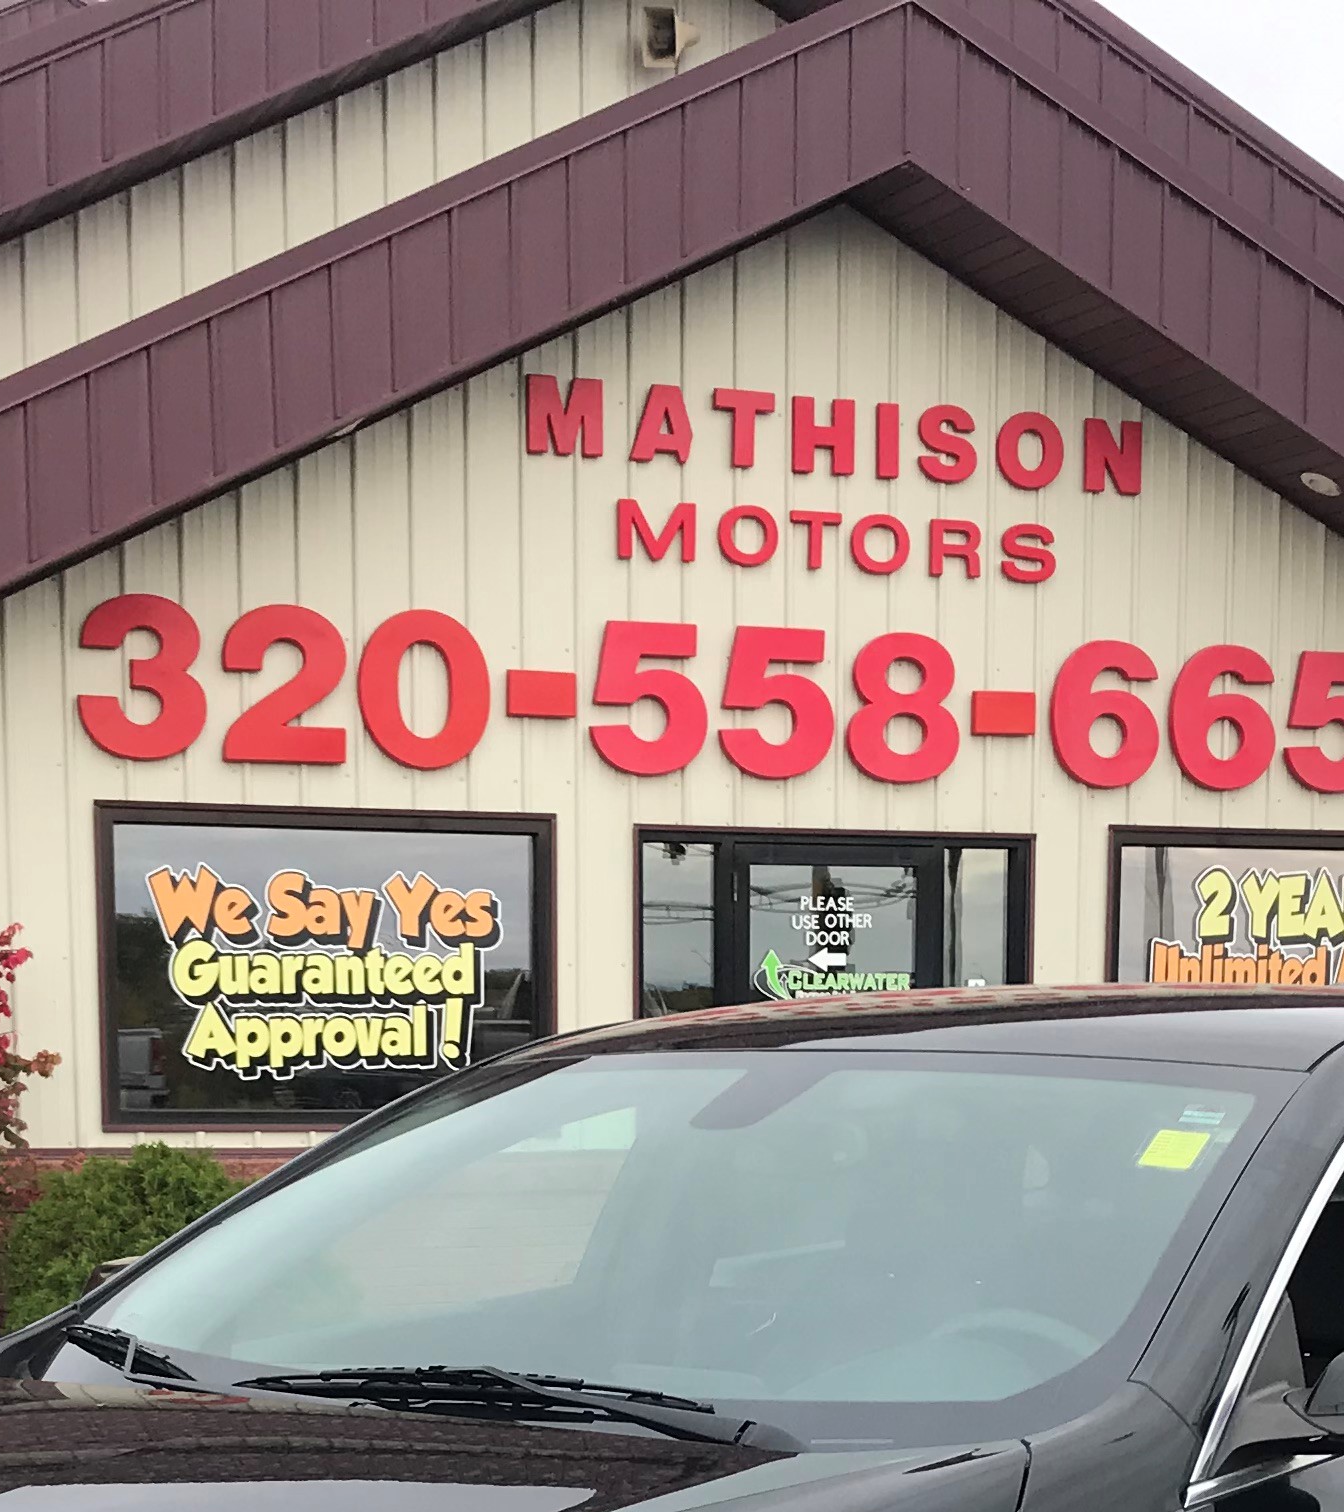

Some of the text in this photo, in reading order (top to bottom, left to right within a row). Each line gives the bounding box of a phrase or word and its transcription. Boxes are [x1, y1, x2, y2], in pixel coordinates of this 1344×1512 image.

[525, 373, 1143, 496] MATHISON
[616, 497, 1057, 584] MOTORS
[147, 863, 500, 950] We Say Yes
[792, 912, 873, 930] USE OTHER
[800, 895, 855, 912] PLEASE
[1196, 866, 1237, 942] 2
[805, 930, 850, 946] DOOR
[171, 940, 483, 1004] Guaranteed
[787, 970, 911, 991] CLEARWATER
